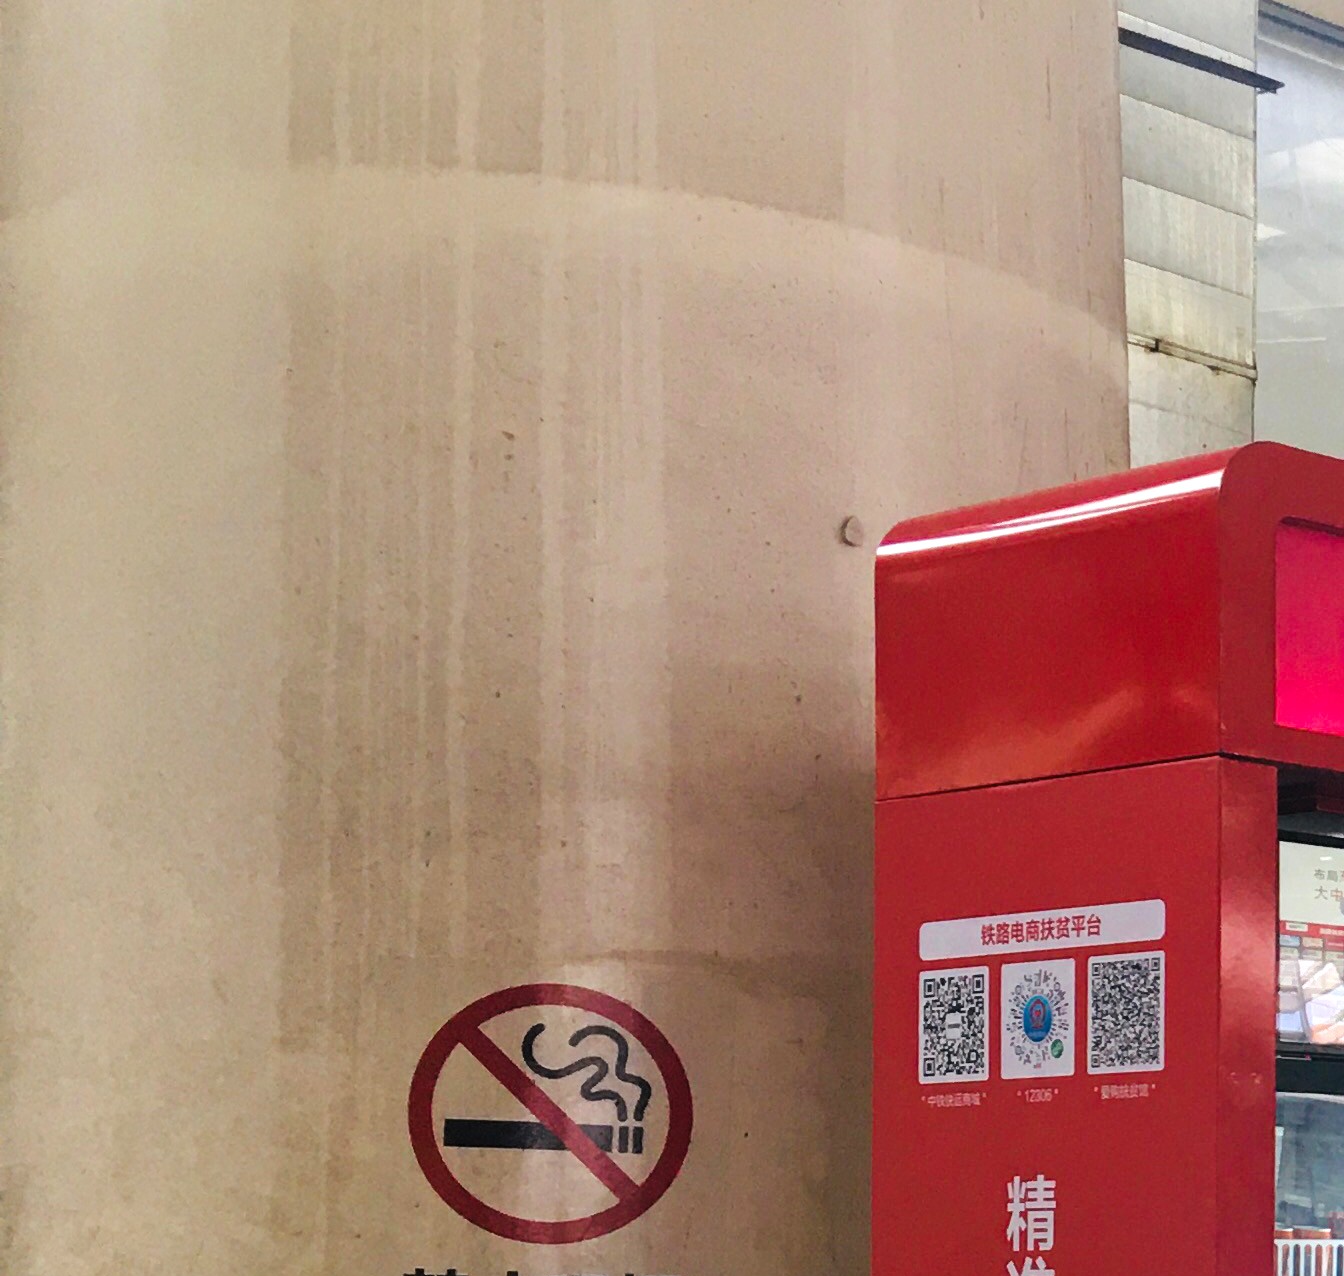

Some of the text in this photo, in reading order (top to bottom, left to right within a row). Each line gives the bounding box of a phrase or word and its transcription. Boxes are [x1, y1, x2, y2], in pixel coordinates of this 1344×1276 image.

[981, 914, 1102, 946] 铁路电商扶贫平台
[1025, 1088, 1053, 1103] 12306
